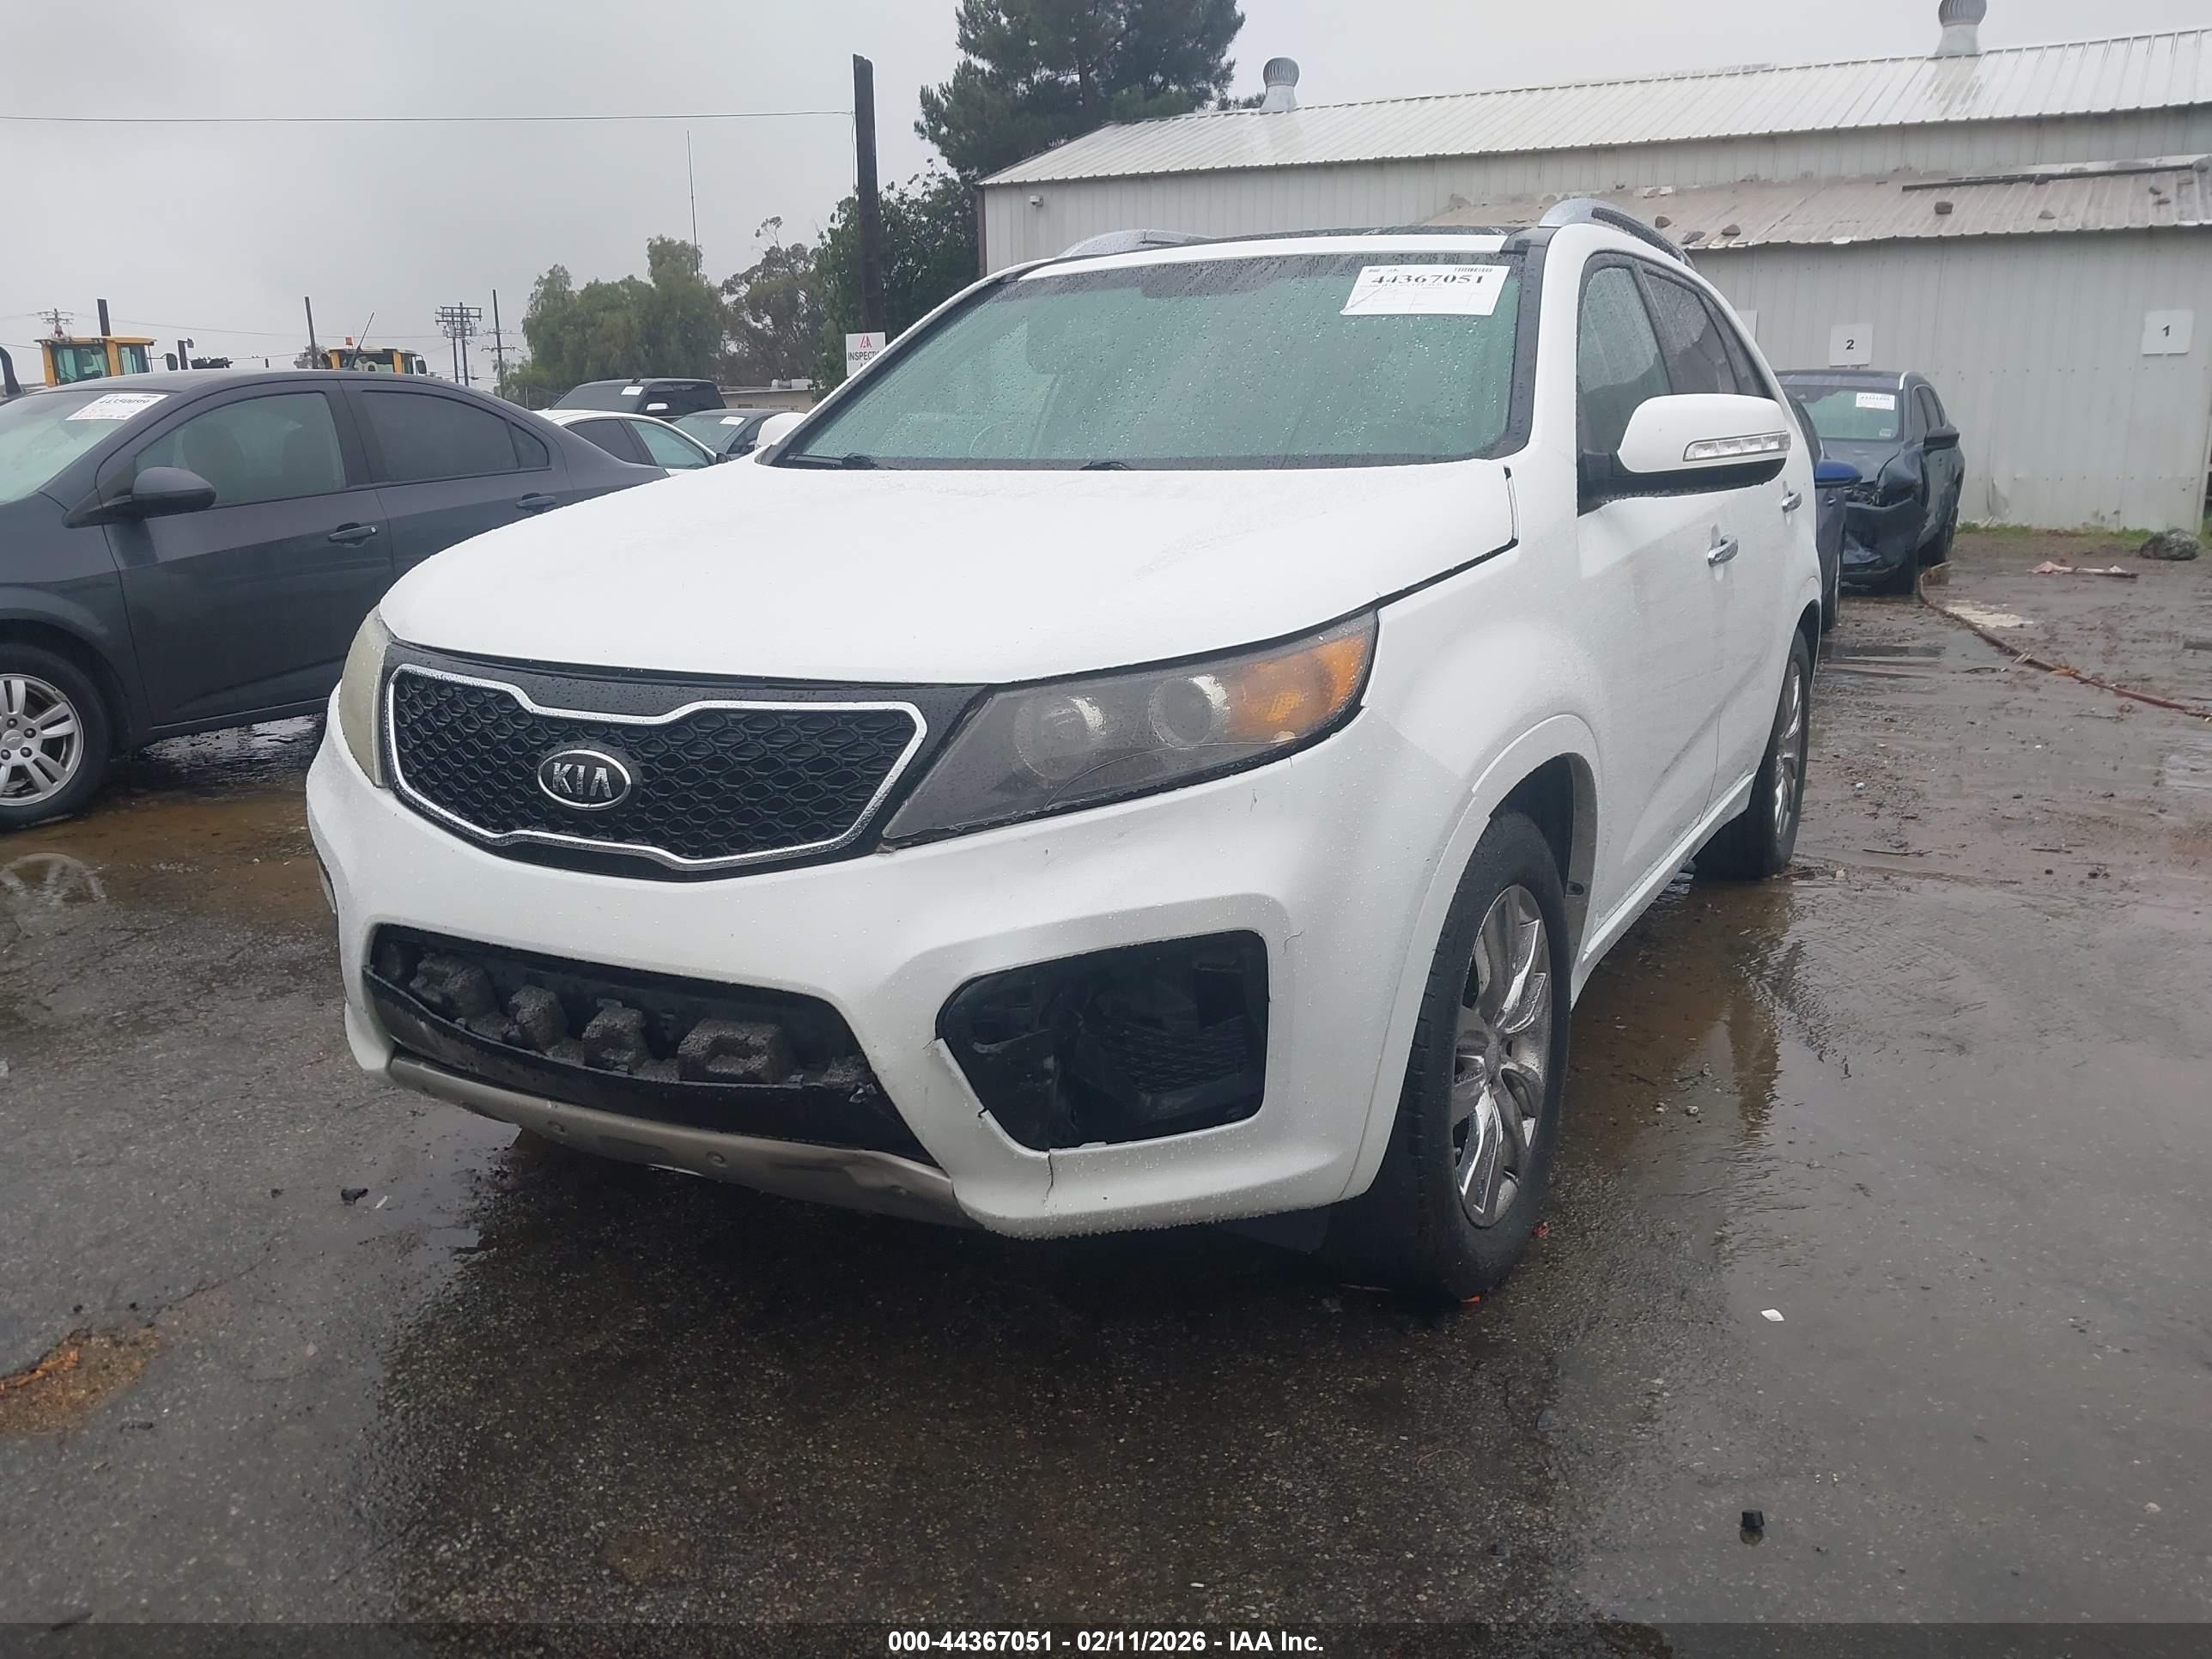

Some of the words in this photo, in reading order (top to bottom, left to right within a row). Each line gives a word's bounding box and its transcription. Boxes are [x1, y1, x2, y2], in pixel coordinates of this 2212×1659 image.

[1371, 274, 1484, 284] 44367051
[2162, 325, 2171, 337] 1
[1845, 339, 1855, 350] 2
[552, 762, 613, 799] KIA
